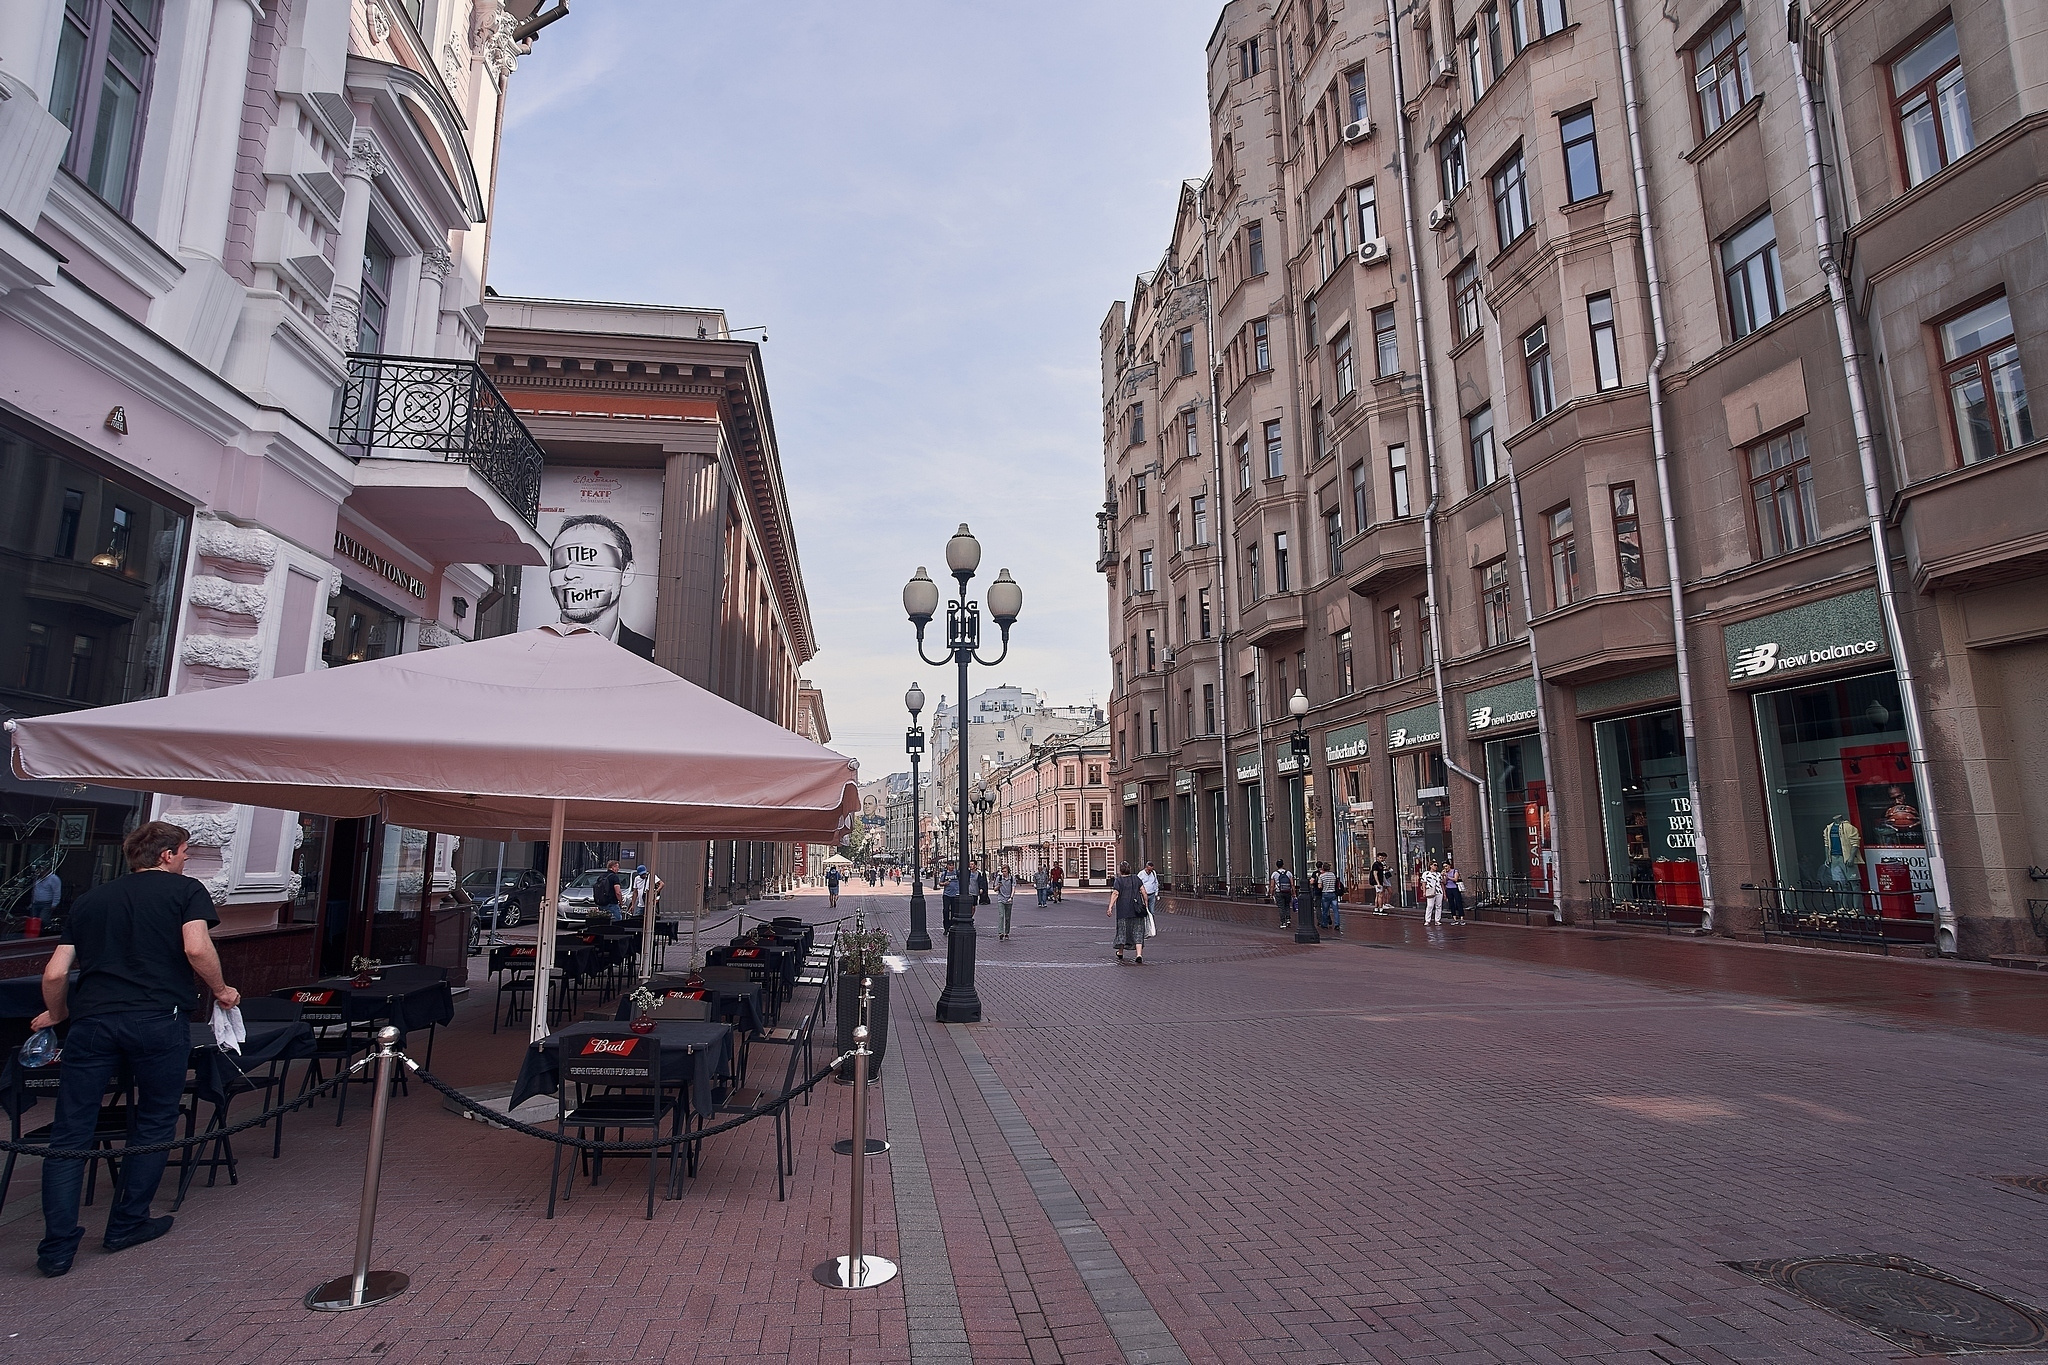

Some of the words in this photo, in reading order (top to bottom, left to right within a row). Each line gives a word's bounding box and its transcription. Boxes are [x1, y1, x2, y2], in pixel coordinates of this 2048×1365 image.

[113, 411, 124, 422] 16
[580, 489, 612, 498] ТЕАТР
[566, 545, 598, 562] ПЕР
[335, 531, 380, 573] IXTEEN
[381, 559, 408, 588] TONS
[408, 576, 427, 599] PUB
[562, 587, 605, 603] ГЮНТ
[1778, 653, 1808, 670] new
[1809, 640, 1879, 663] balance
[1491, 715, 1506, 726] new
[1505, 709, 1538, 723] balance
[1405, 737, 1417, 746] new
[1416, 731, 1440, 744] balance
[1325, 740, 1358, 762] Timberland
[1670, 797, 1691, 812] ТВ
[1667, 815, 1694, 830] ВРЕ
[1528, 825, 1540, 866] SALE
[1666, 830, 1696, 848] СЕЙ
[1898, 856, 1927, 868] ВОЕ
[737, 948, 754, 956] Bud
[296, 991, 324, 1003] Bud
[590, 1039, 626, 1053] Bud
